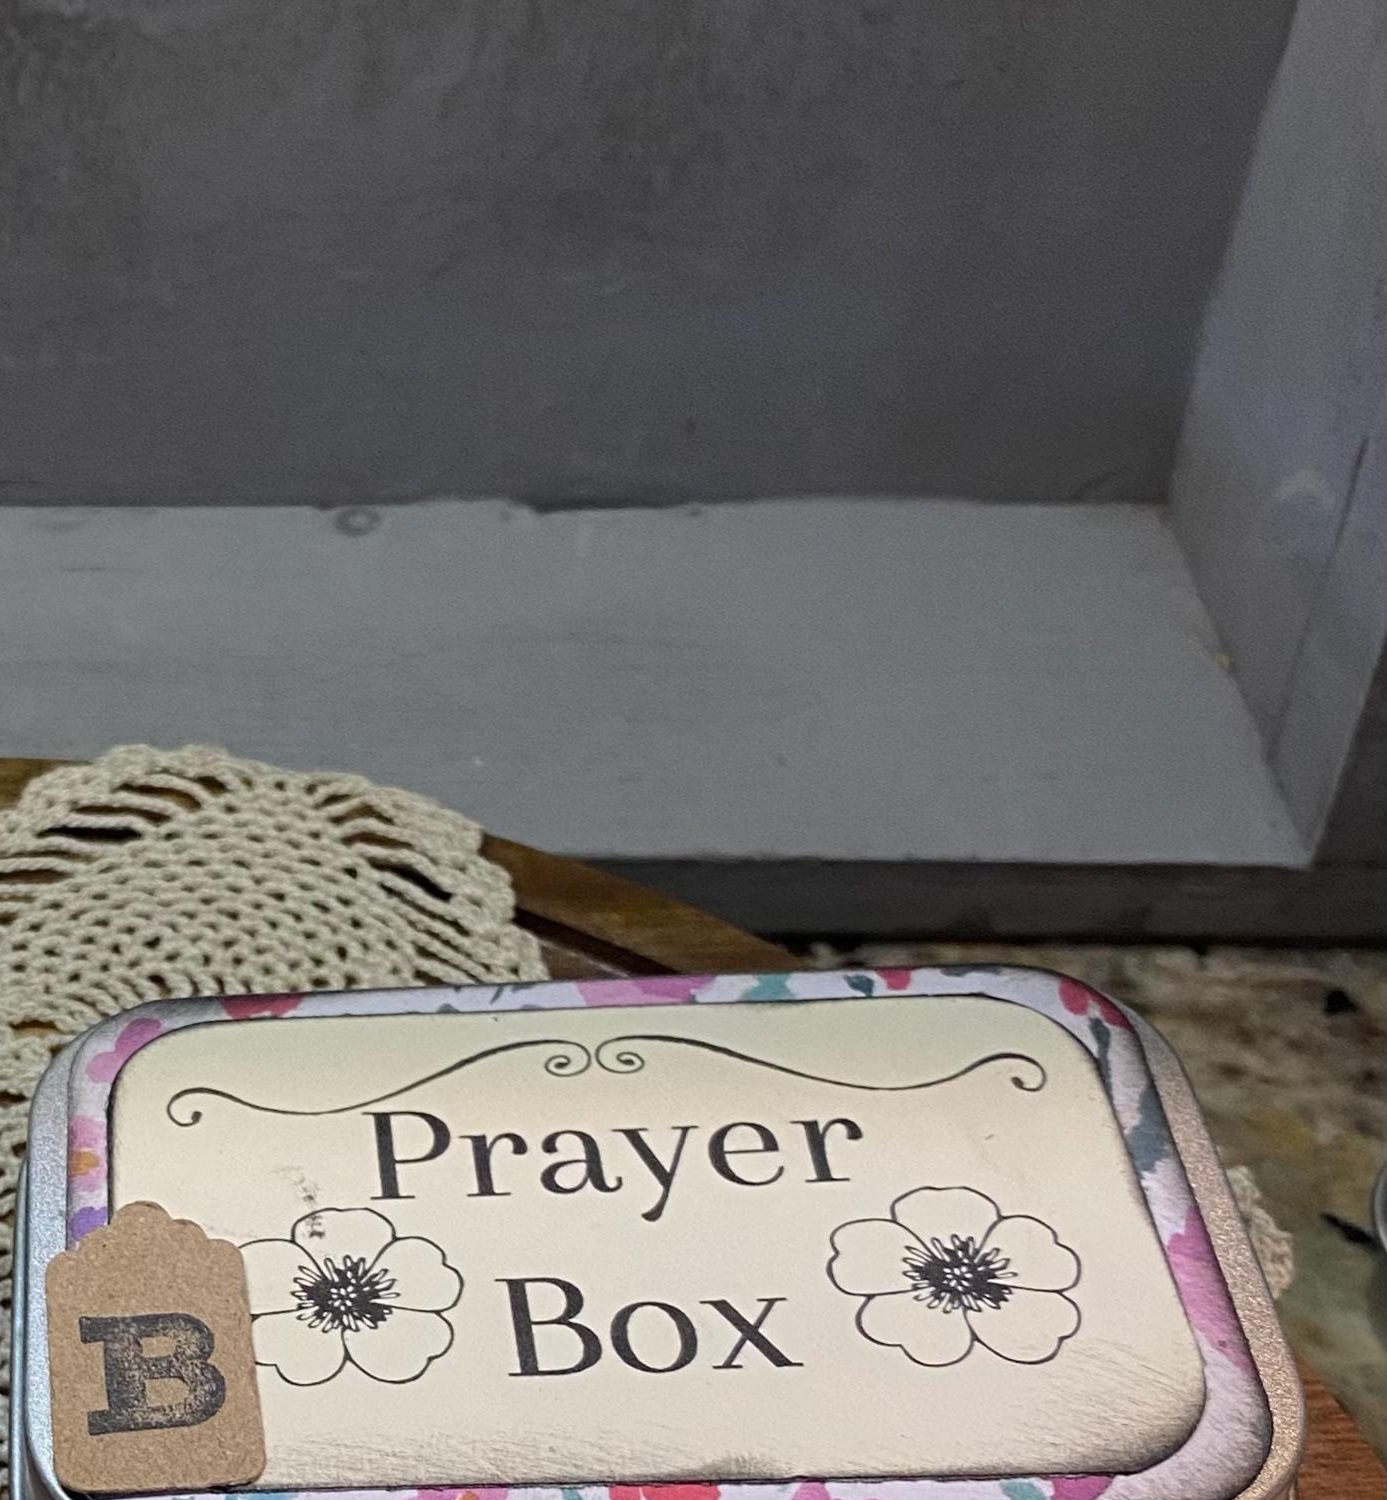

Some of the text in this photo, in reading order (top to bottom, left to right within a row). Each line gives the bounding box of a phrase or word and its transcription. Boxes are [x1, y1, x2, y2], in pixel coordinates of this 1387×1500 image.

[361, 1110, 864, 1223] Prayer
[78, 1312, 228, 1437] B
[494, 1277, 805, 1377] Box
